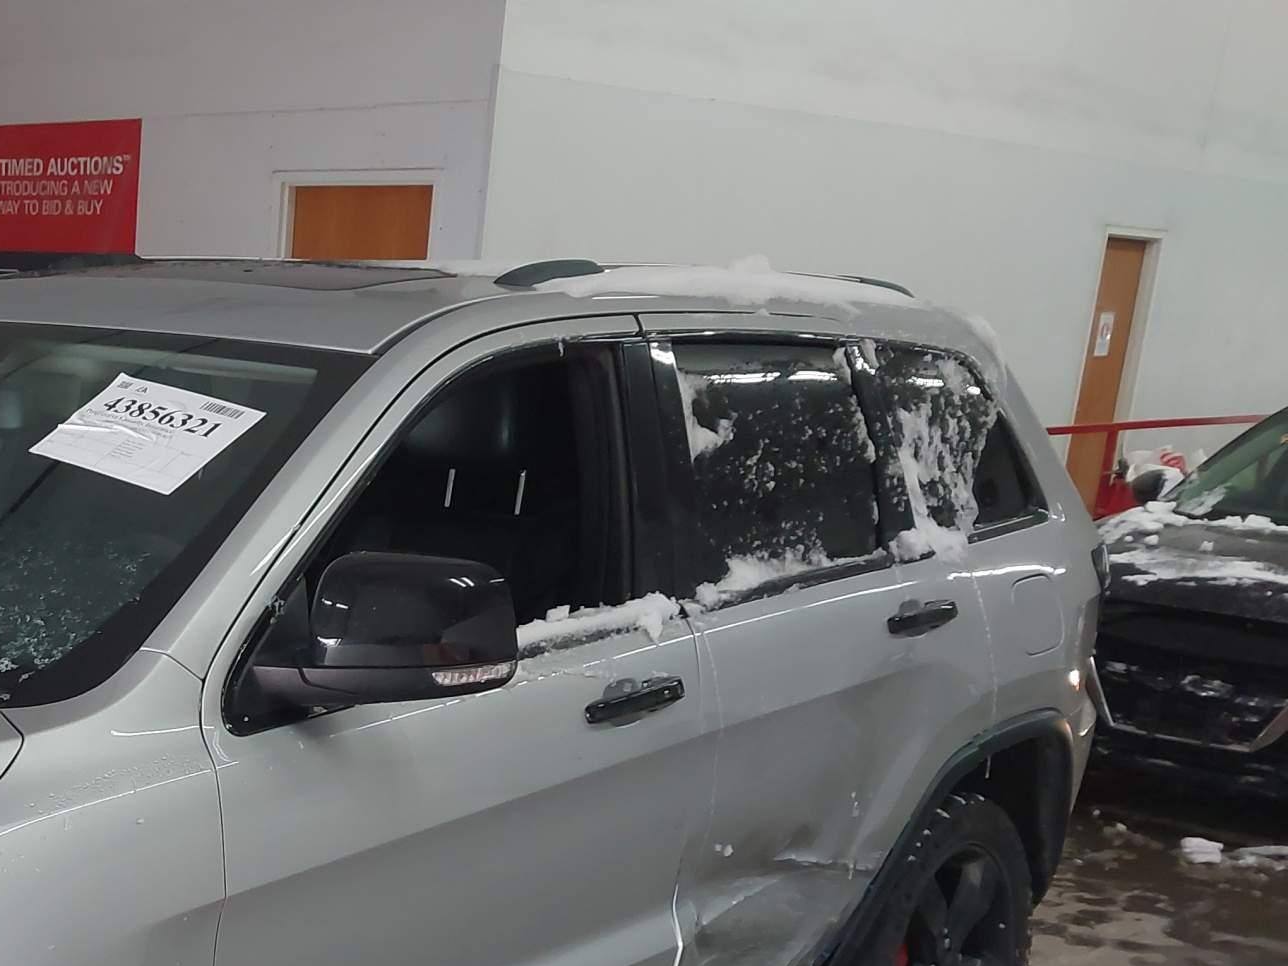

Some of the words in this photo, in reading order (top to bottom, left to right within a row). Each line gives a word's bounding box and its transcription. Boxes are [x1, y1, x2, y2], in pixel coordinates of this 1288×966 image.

[70, 180, 81, 196] A
[84, 179, 113, 196] NEW
[23, 199, 40, 216] TO
[42, 199, 62, 216] BID
[64, 199, 75, 216] &
[77, 199, 104, 216] BUY
[103, 396, 223, 438] 43856321
